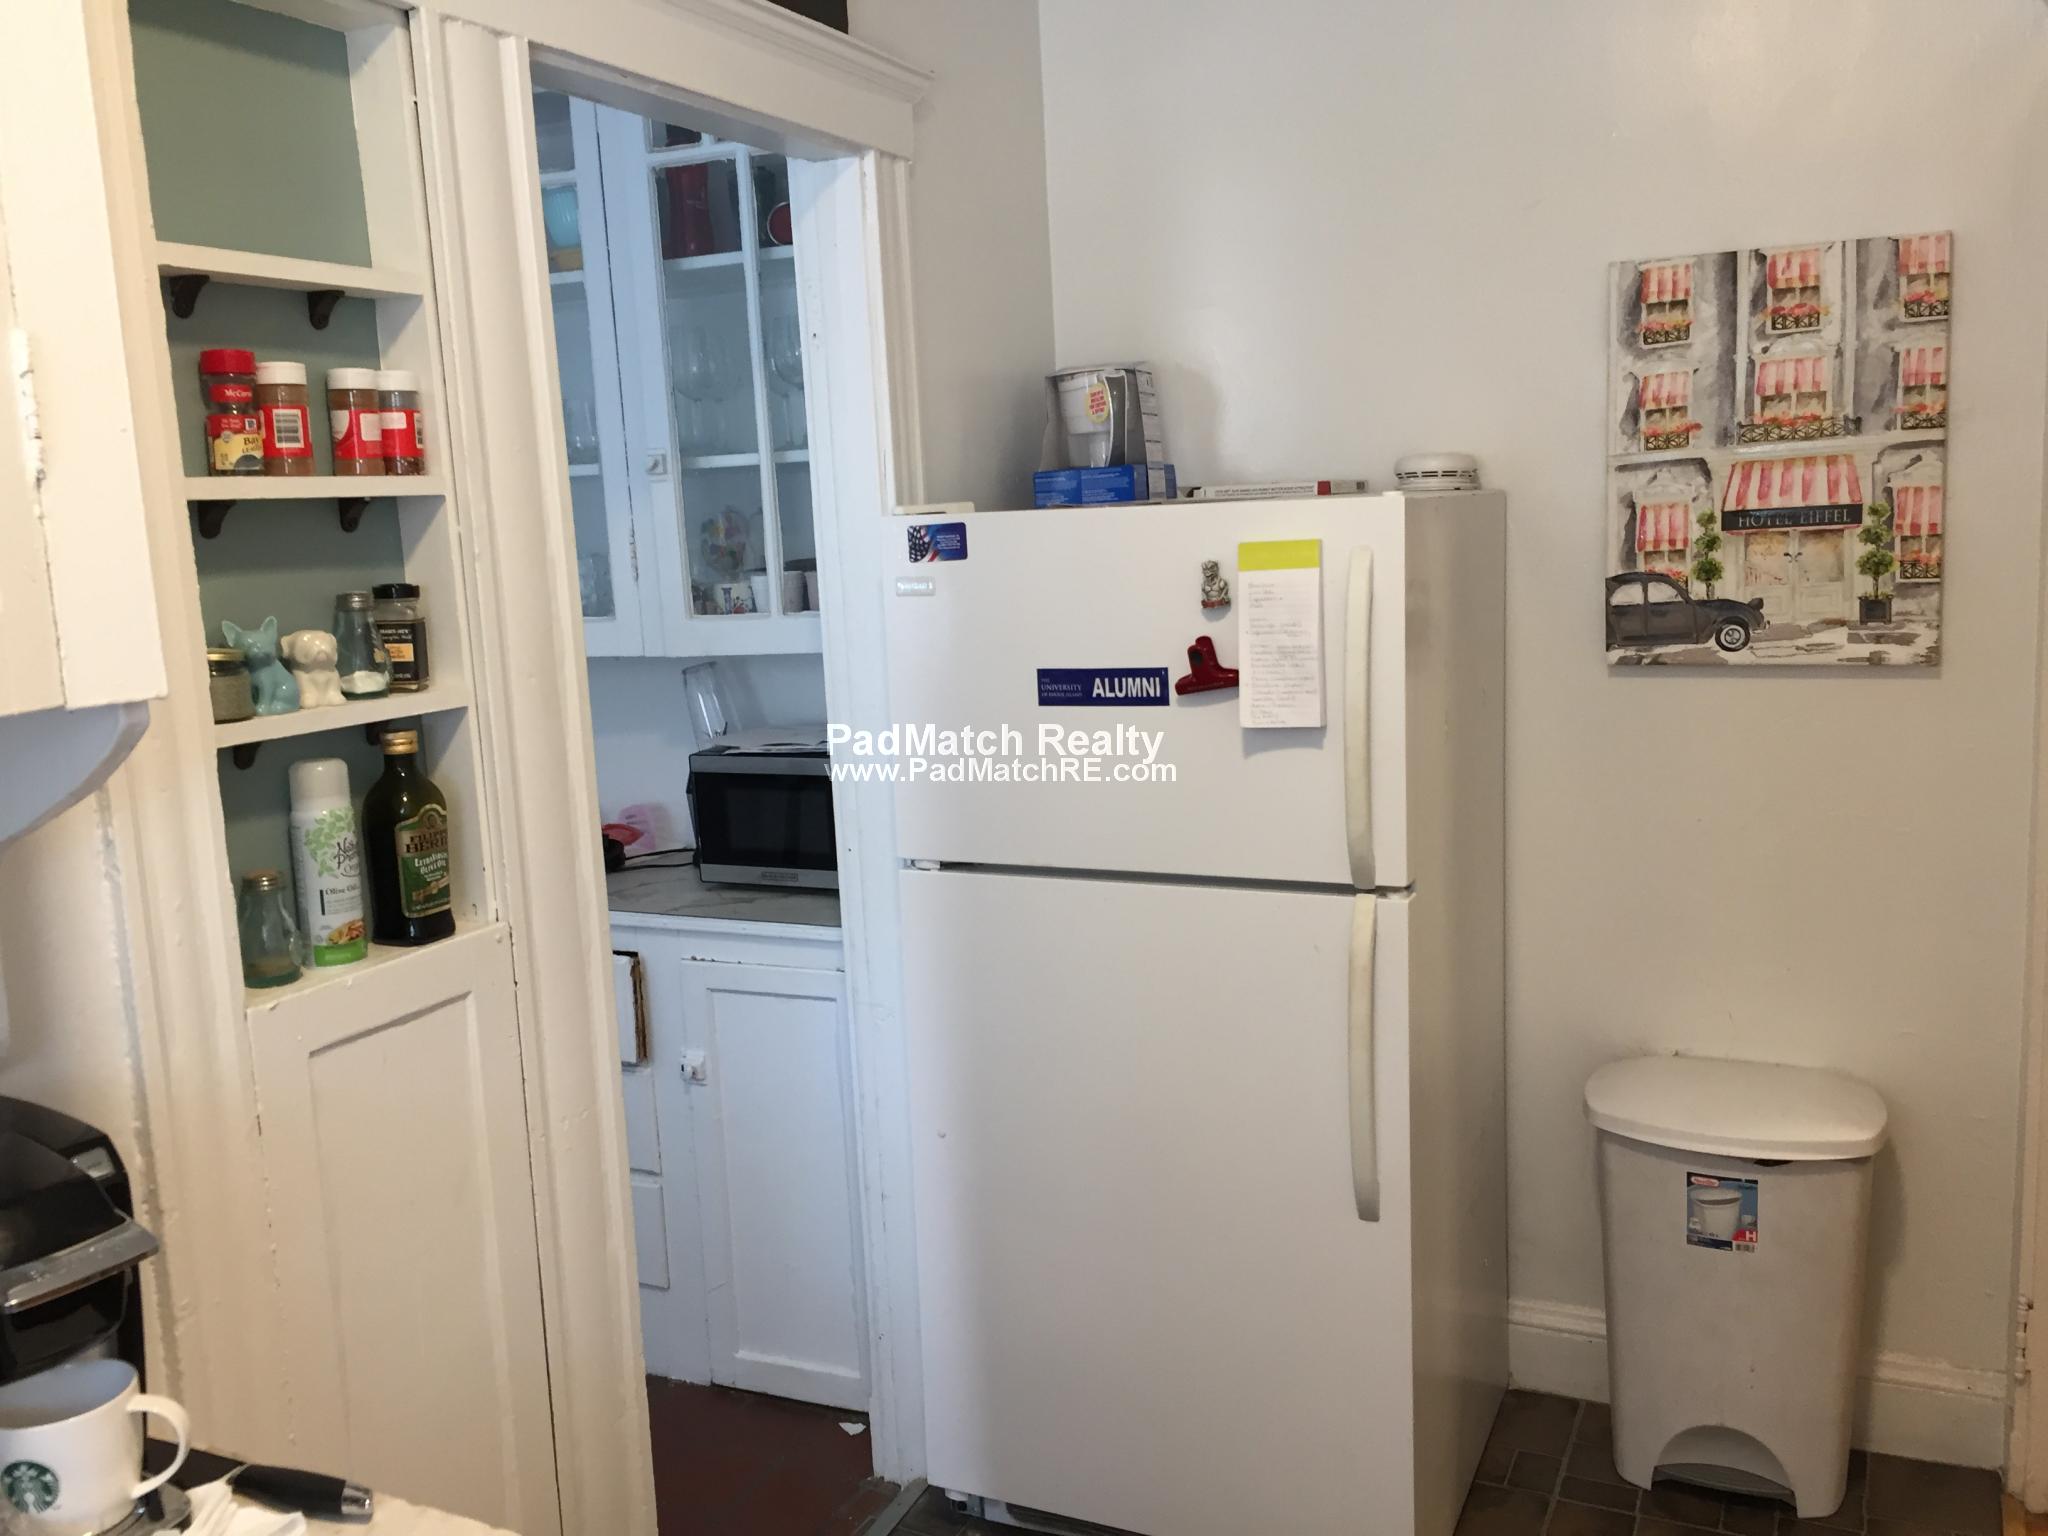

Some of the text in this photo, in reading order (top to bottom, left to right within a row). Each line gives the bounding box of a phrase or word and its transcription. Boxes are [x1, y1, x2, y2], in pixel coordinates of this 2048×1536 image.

[1800, 508, 1851, 524] EIFFEL
[1041, 683, 1082, 691] UNIVERSITY
[1092, 677, 1161, 698] ALUMNI
[325, 886, 346, 896] Olive
